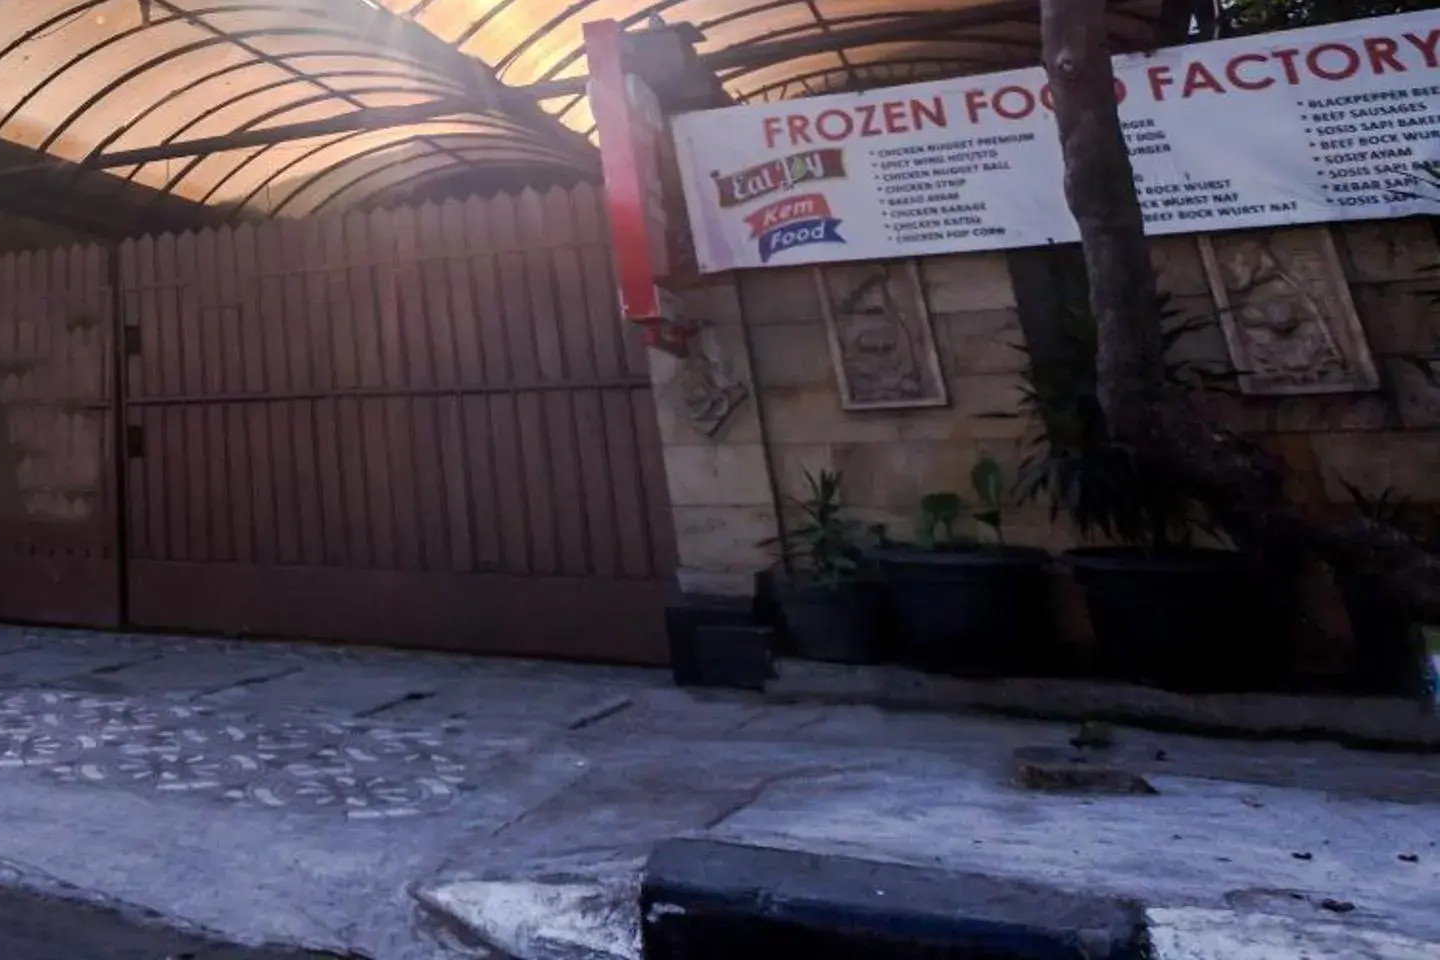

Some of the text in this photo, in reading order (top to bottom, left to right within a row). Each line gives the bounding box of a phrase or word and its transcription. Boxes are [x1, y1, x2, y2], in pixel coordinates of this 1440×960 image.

[762, 29, 1440, 148] FROZEN FO FACTORY
[1308, 85, 1440, 109] BLACKPEPPER BEE
[1312, 102, 1427, 122] BEEF SAUSAGES
[1316, 124, 1357, 136] SOSIS
[1361, 119, 1394, 132] SAPI
[1320, 129, 1440, 150] BEEF BOCK WUR
[878, 147, 925, 158] CHICKEN
[1129, 144, 1171, 156] URGER
[1324, 147, 1412, 164] SOSIS AYAM
[883, 161, 1011, 182] CHICKEN NUGGET BALL
[1329, 165, 1370, 179] SOSIS
[1373, 162, 1408, 175] SAPI
[731, 170, 774, 200] Eat
[1146, 184, 1180, 196] BOCK
[1184, 179, 1232, 192] WURST
[1162, 195, 1209, 207] WURST
[1179, 208, 1214, 220] BOCK
[1218, 205, 1266, 216] WURST
[1270, 201, 1298, 212] NAT
[1337, 195, 1379, 207] SOSIS
[762, 200, 815, 227] Kem
[770, 222, 826, 250] Food
